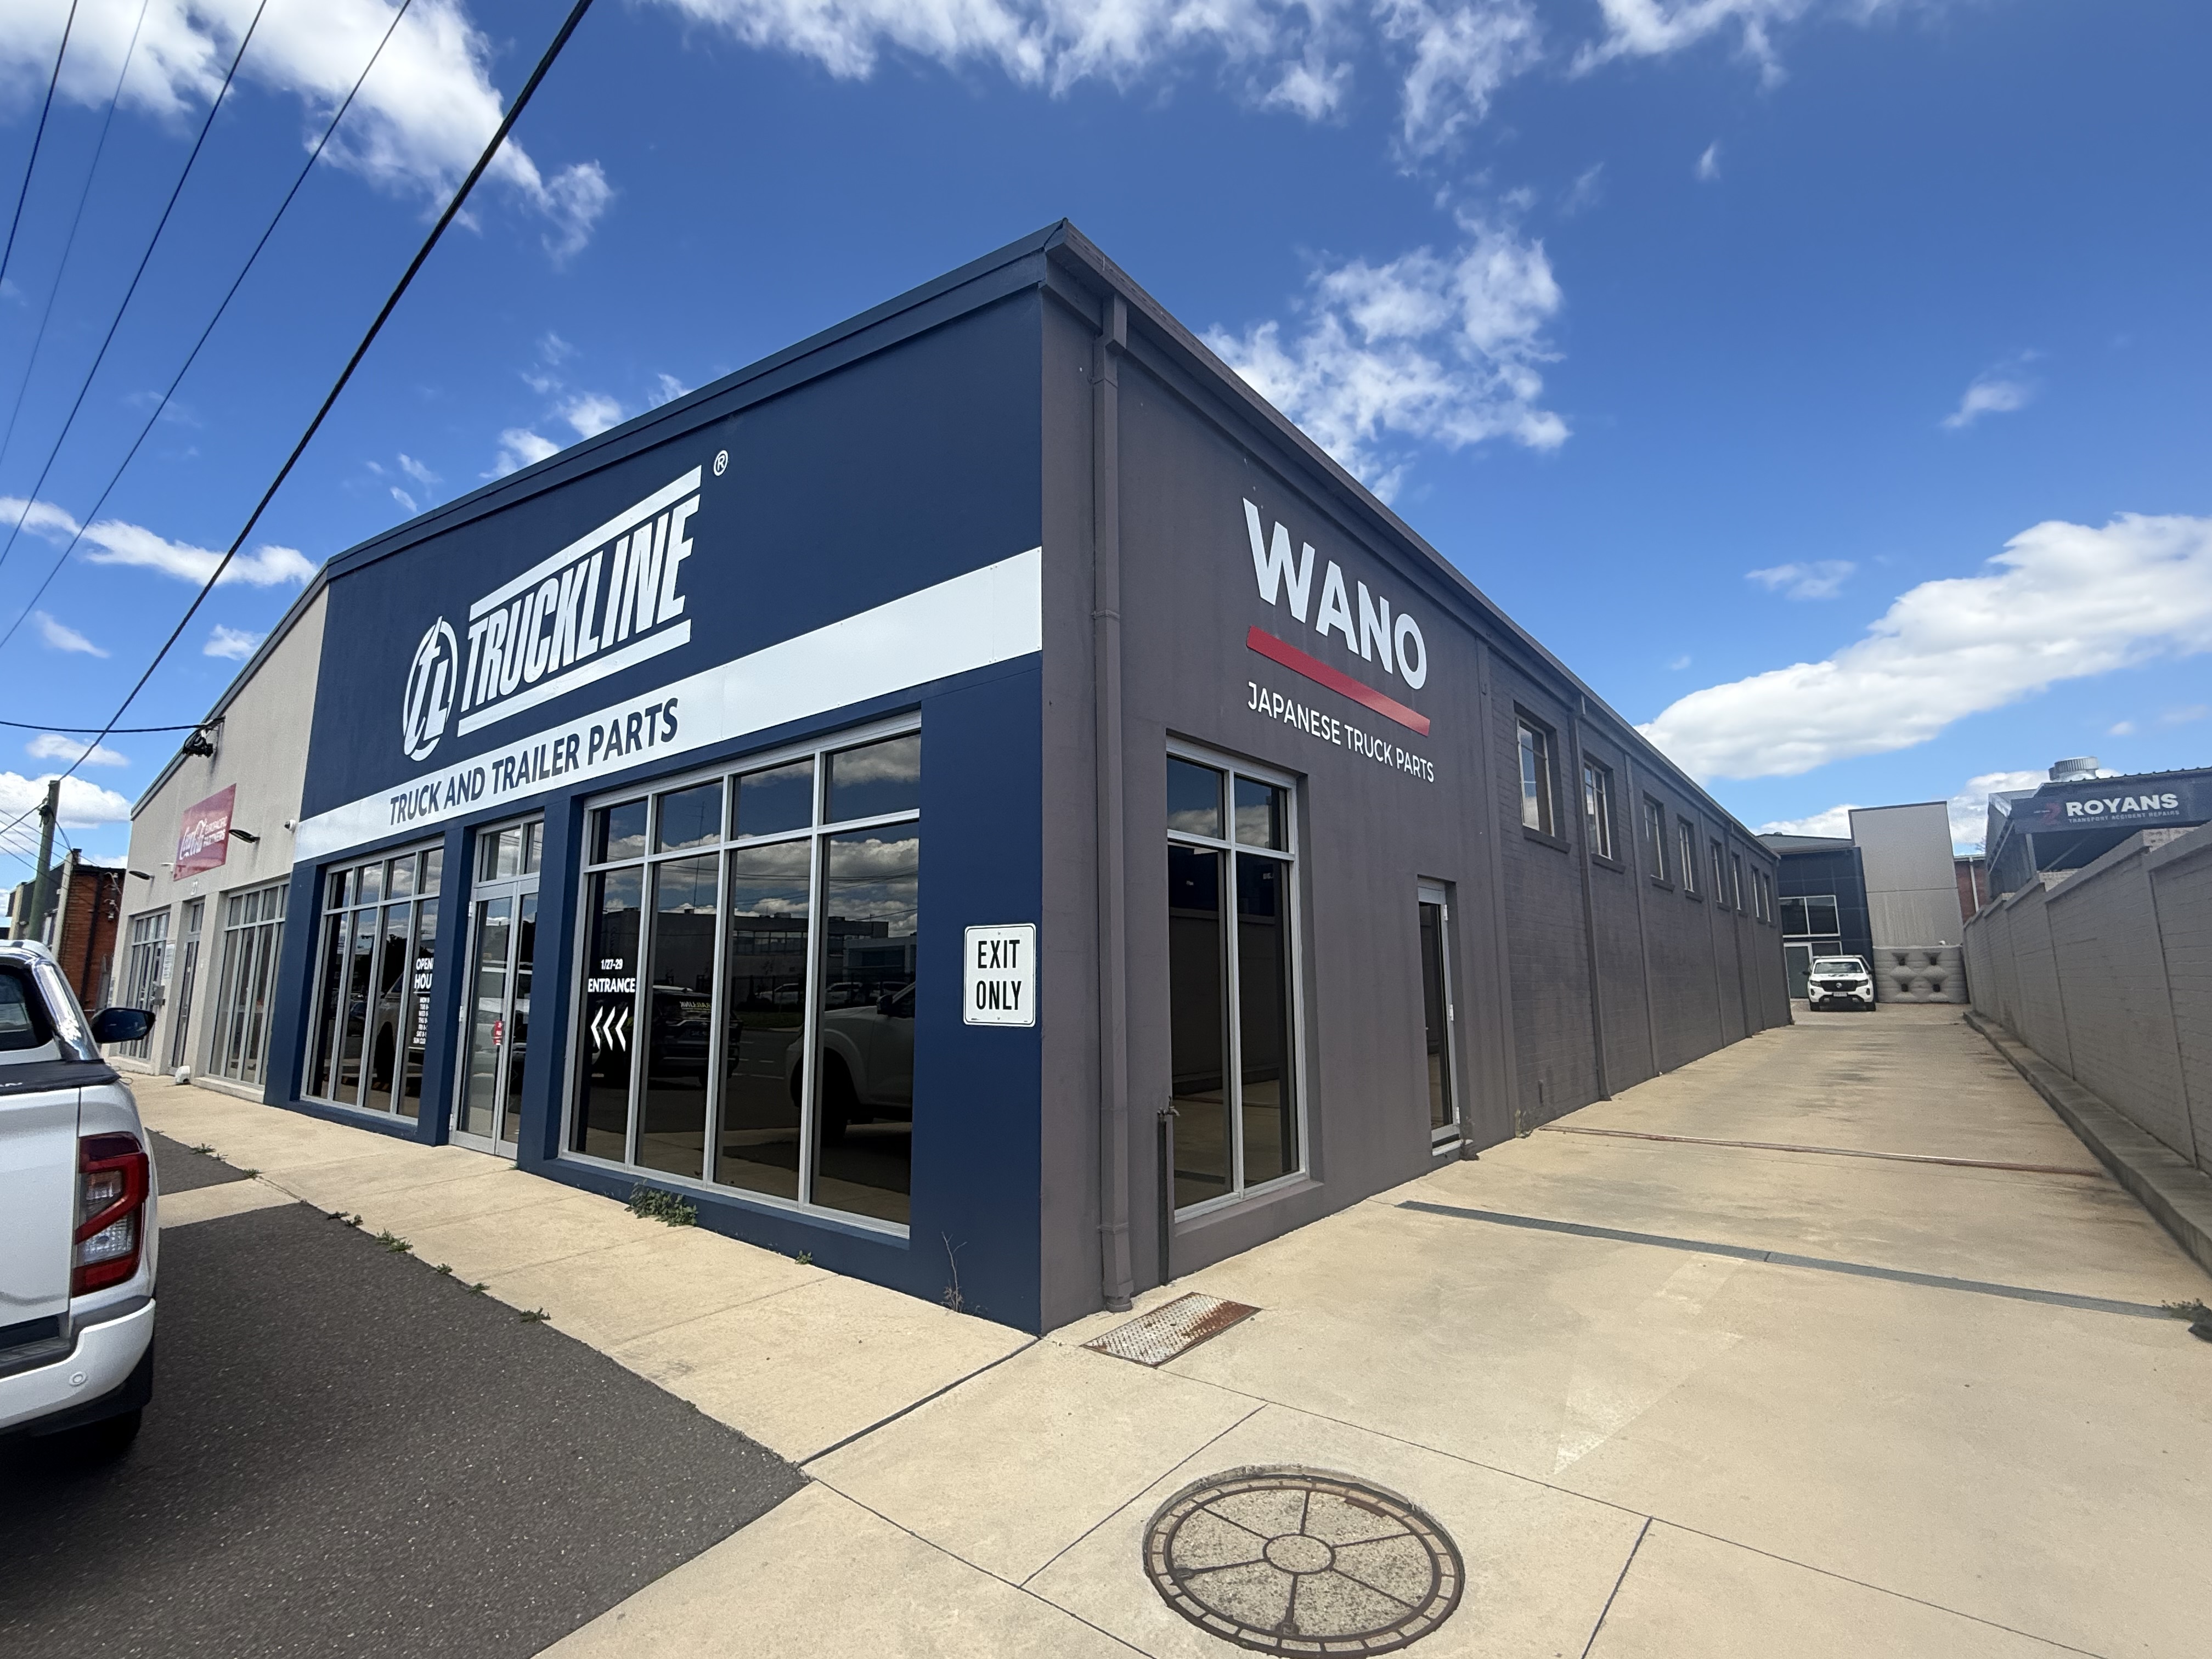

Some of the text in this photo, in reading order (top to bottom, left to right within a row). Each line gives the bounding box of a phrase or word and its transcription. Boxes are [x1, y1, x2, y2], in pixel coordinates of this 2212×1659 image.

[461, 494, 700, 712] TRUCKLINE
[1243, 497, 1427, 690] WANO
[1248, 681, 1434, 783] JAPANESE TRUCK PARTS
[390, 697, 679, 826] TRUCK AND TRAILER PARTS
[2066, 793, 2179, 816] ROYANS
[2068, 815, 2109, 823] TRANSPORT
[601, 958, 623, 970] 1/27-29
[978, 939, 1020, 969] EXIT
[588, 978, 635, 992] ENTRANCE
[976, 980, 1022, 1010] ONLY
